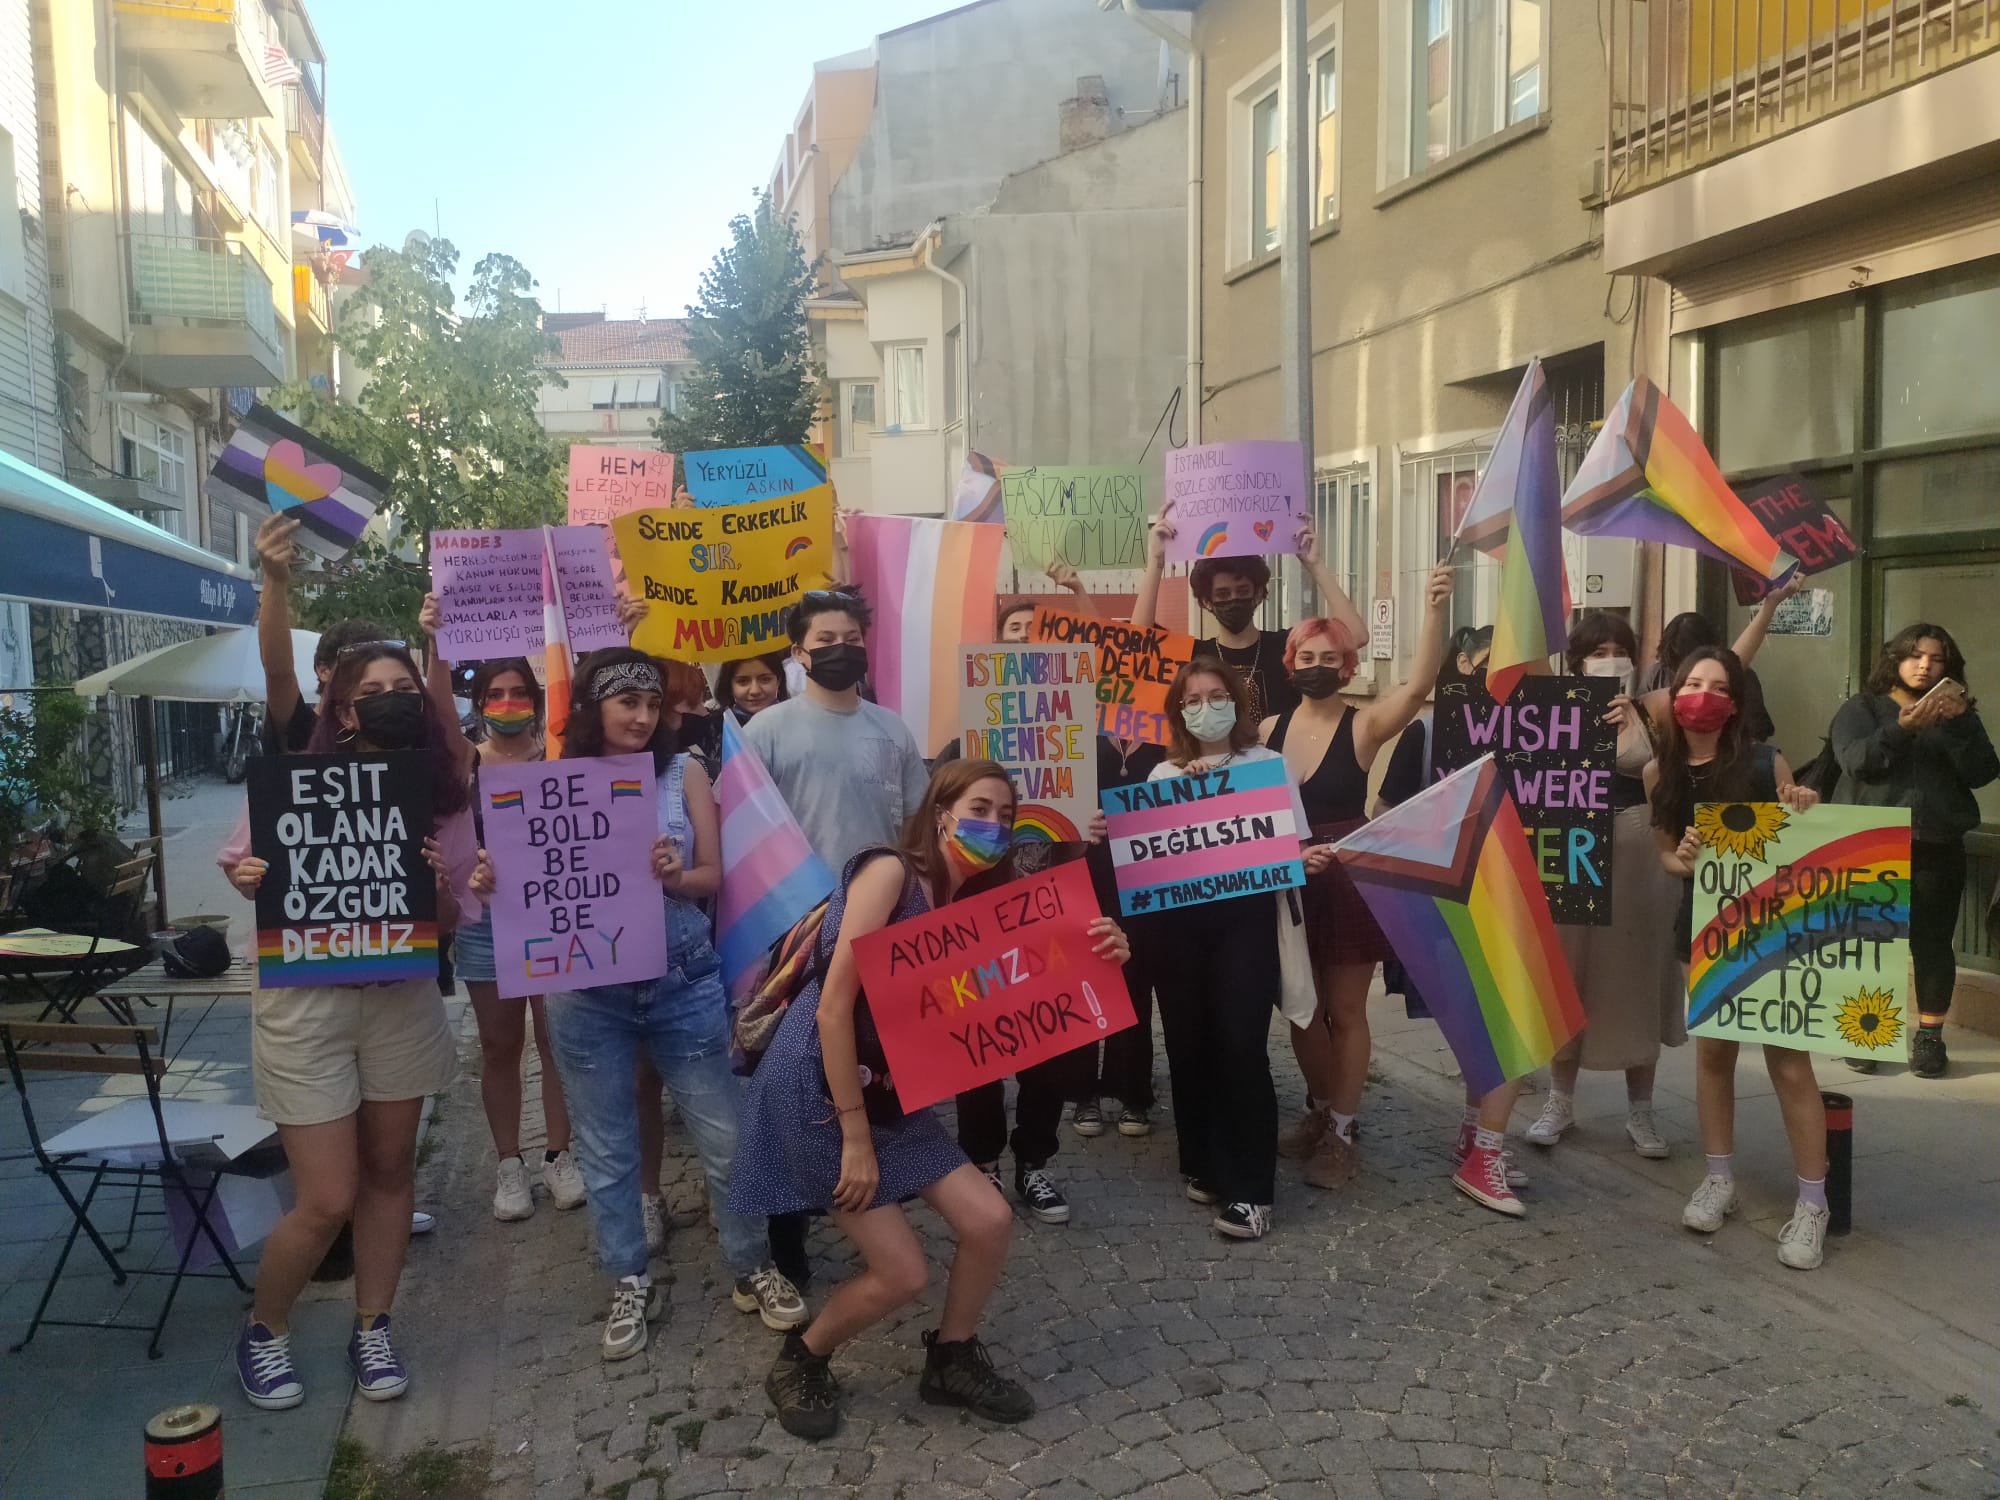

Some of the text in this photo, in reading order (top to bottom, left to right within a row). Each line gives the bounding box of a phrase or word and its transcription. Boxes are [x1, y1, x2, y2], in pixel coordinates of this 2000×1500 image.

[600, 456, 646, 477] HEM
[696, 458, 767, 482] YERYÜZÜ
[575, 477, 667, 498] LEZBİYEN
[604, 495, 632, 508] HEM
[746, 478, 794, 497] AŞKIN
[1750, 483, 1810, 521] THE
[573, 506, 619, 521] MEZBİY
[638, 501, 808, 541] SENDE ERKEKLİK
[435, 536, 502, 550] MADDE 3
[1775, 514, 1857, 567] EM
[489, 584, 502, 592] VE
[644, 573, 800, 606] BENDE KADINLIK
[565, 604, 616, 619] GÖSTER
[527, 637, 546, 650] HAK
[966, 651, 1095, 688] İSTANBUL'A
[985, 689, 1073, 725] SELAM
[966, 724, 1085, 763] DİRENİŞE
[1463, 703, 1581, 752] WISH
[291, 762, 388, 809] EŞİT
[540, 773, 590, 810] BE
[1007, 766, 1074, 801] EVAM
[1513, 768, 1611, 809] WERE
[276, 806, 408, 846] OLANA
[527, 811, 610, 846] BOLD
[289, 843, 407, 884] KADAR
[543, 845, 588, 877] BE
[283, 881, 409, 921] ÖZGÜR
[523, 872, 621, 908] PROUD
[1700, 860, 1899, 905] OUR BODIES
[550, 903, 595, 934] BE
[890, 876, 1065, 976] AYDAN EZGİ
[1717, 894, 1900, 935] OUR LIVES
[282, 921, 414, 964] DEĞİLİZ
[524, 926, 624, 979] GAY
[1703, 925, 1894, 973] OUR RIGHT
[1778, 964, 1822, 1003] TO
[1717, 997, 1827, 1039] DECIDE
